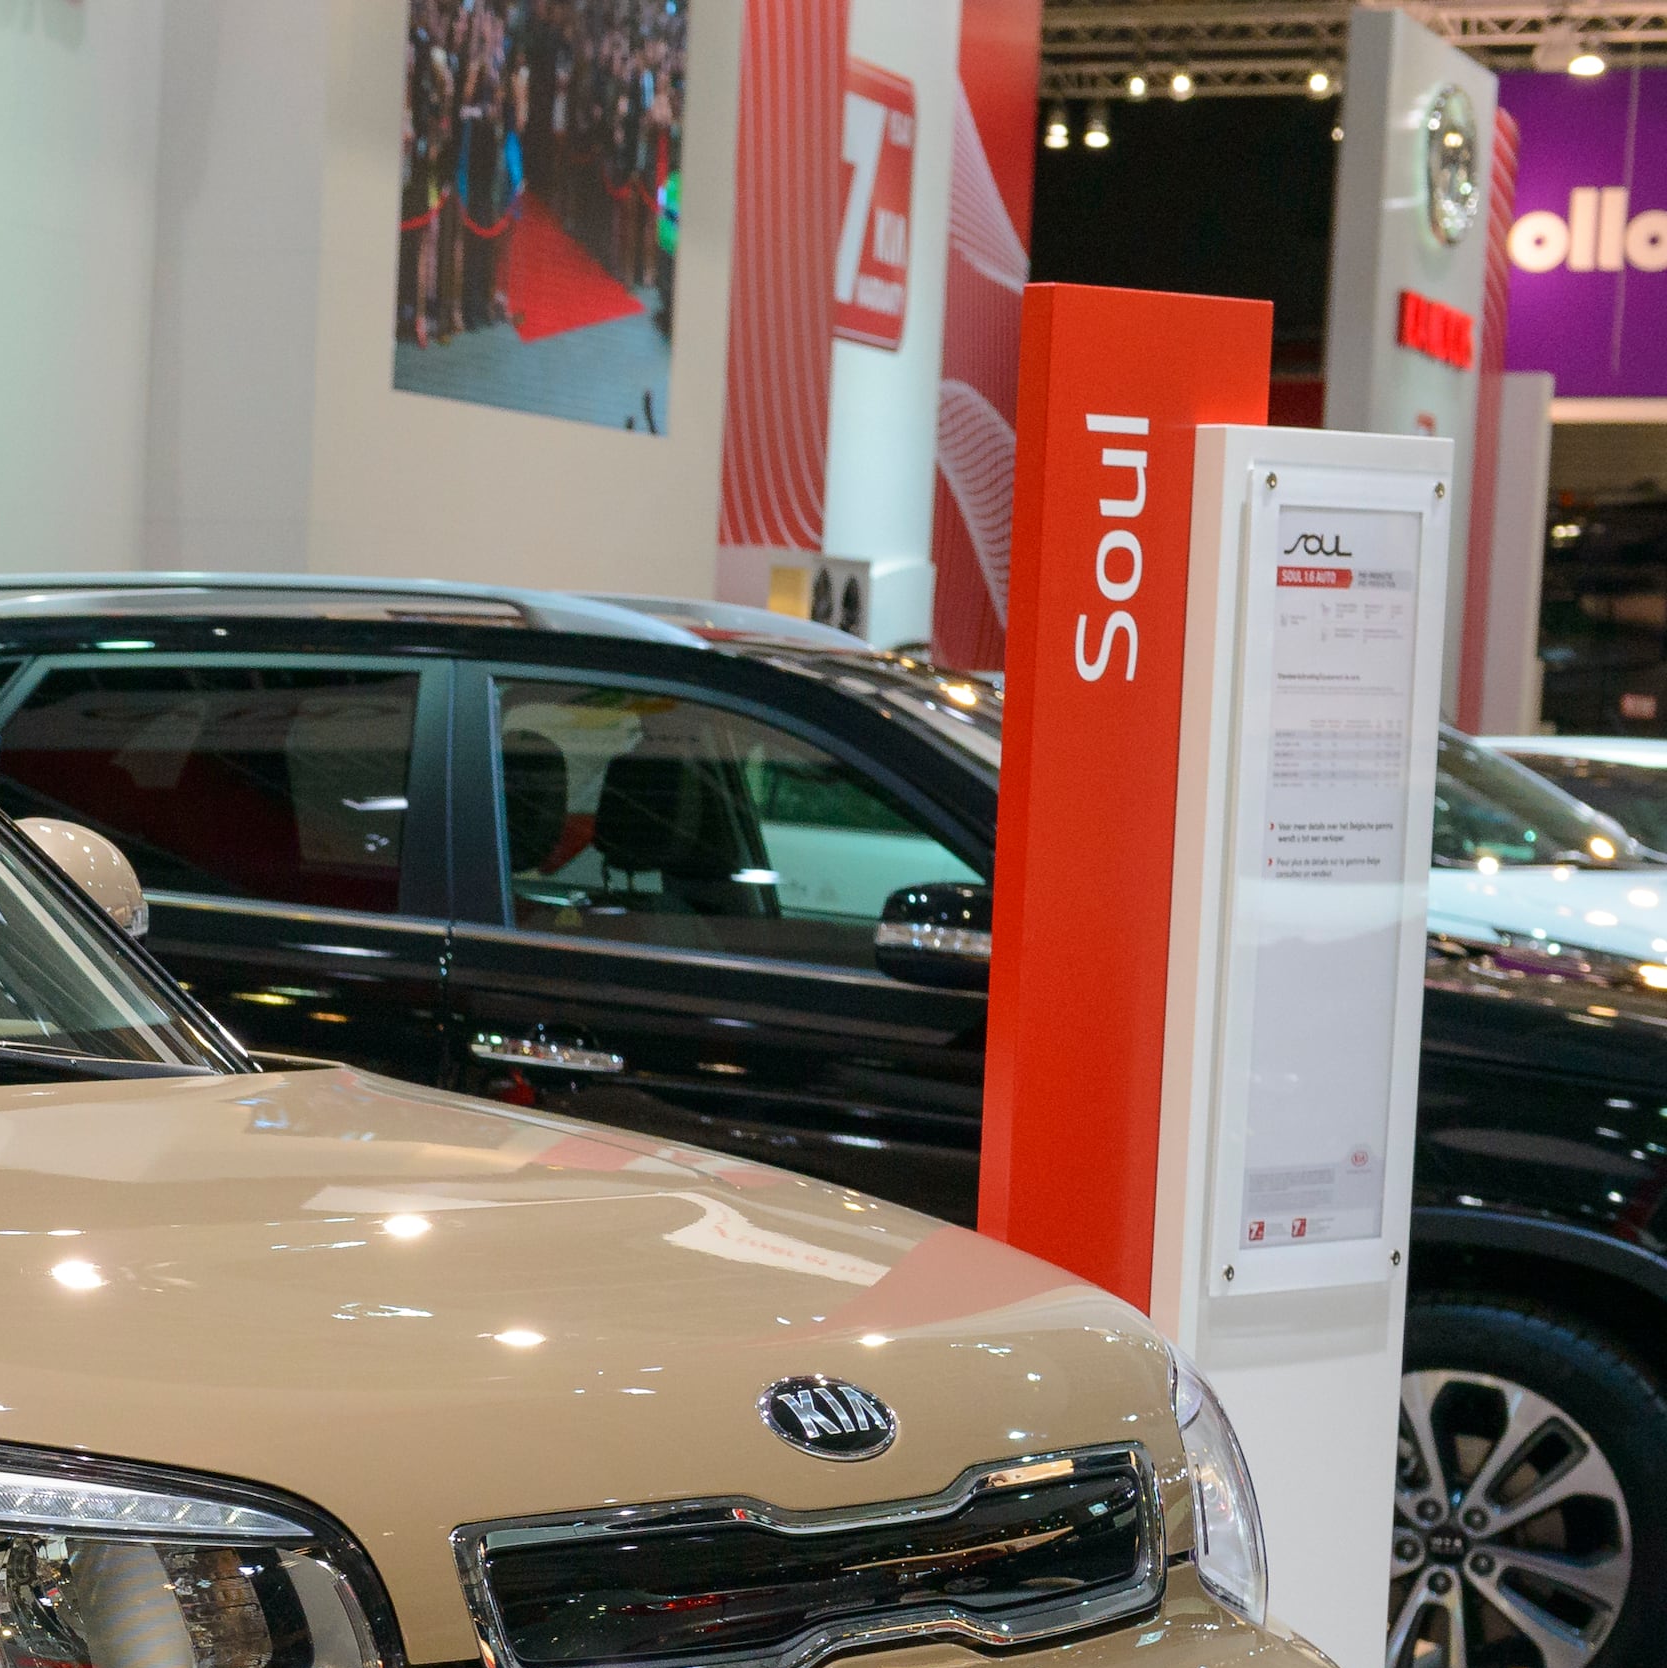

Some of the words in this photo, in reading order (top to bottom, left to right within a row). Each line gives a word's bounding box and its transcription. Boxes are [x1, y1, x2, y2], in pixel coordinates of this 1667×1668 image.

[835, 91, 888, 303] 7
[1075, 413, 1149, 682] Soul
[1284, 534, 1352, 556] SOUL
[777, 1386, 888, 1438] KIA
